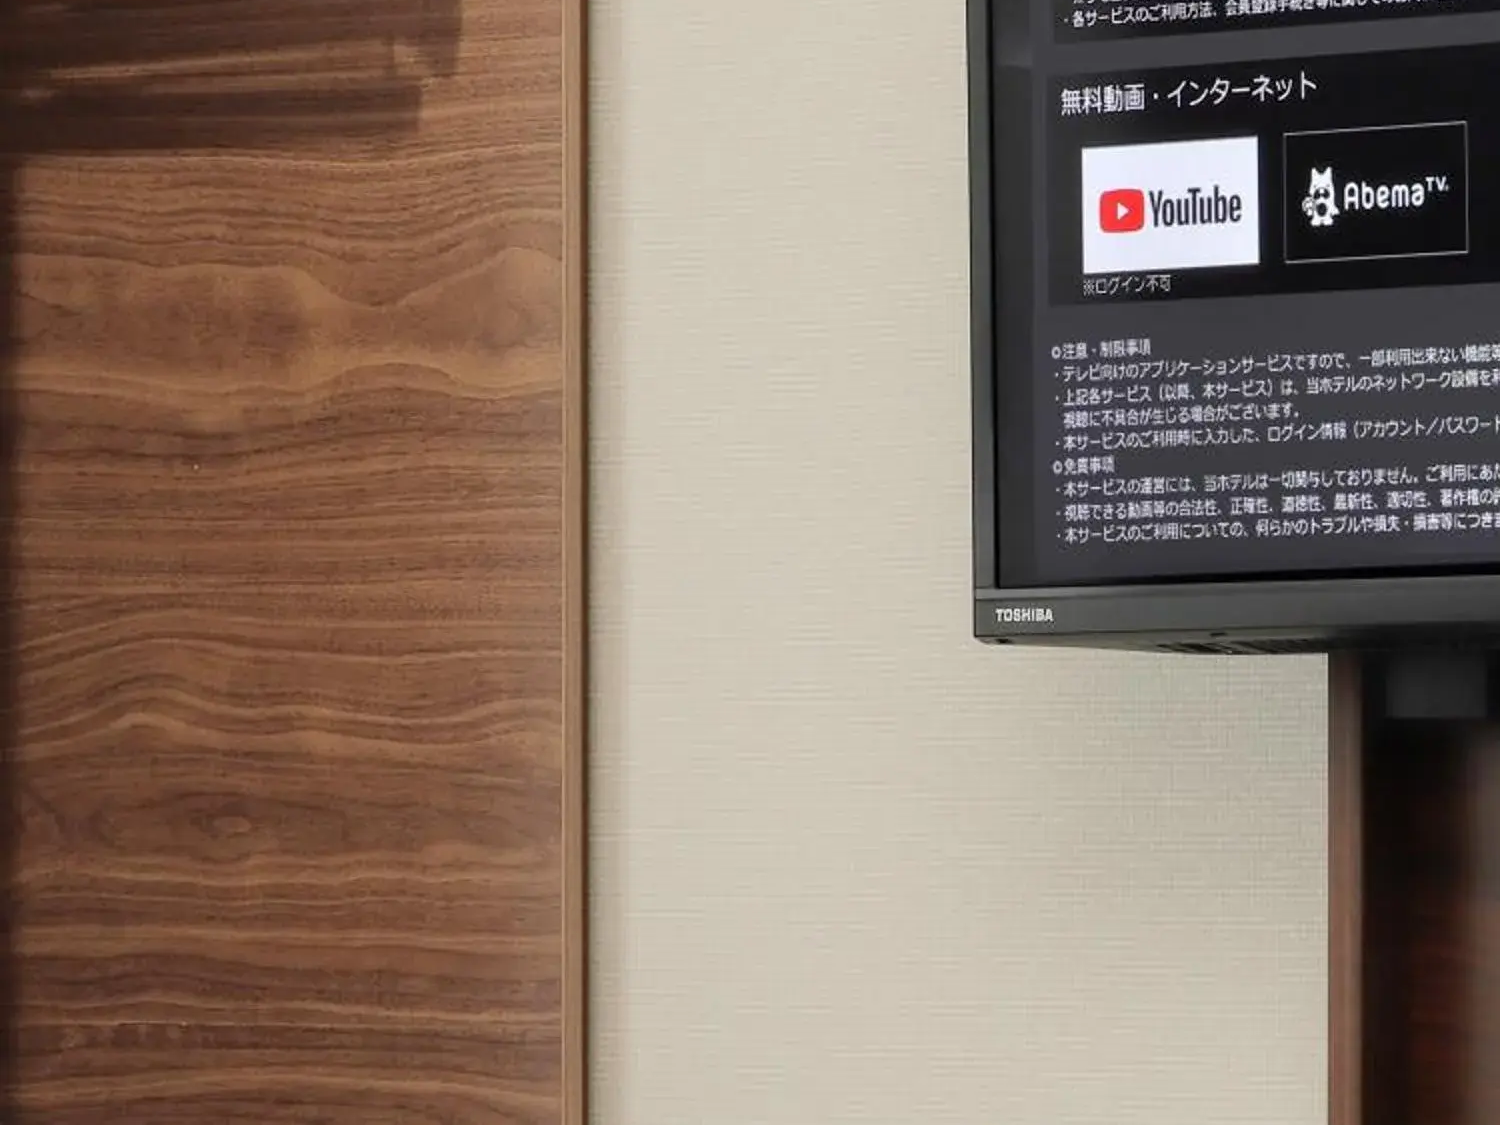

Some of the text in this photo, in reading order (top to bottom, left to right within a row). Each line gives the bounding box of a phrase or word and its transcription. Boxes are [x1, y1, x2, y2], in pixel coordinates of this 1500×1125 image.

[1060, 70, 1318, 116] 無料動画・インターネット
[1149, 184, 1243, 228] YouTube
[1082, 274, 1172, 296] ※ログイン不可
[994, 607, 1055, 622] TOSHIBA
